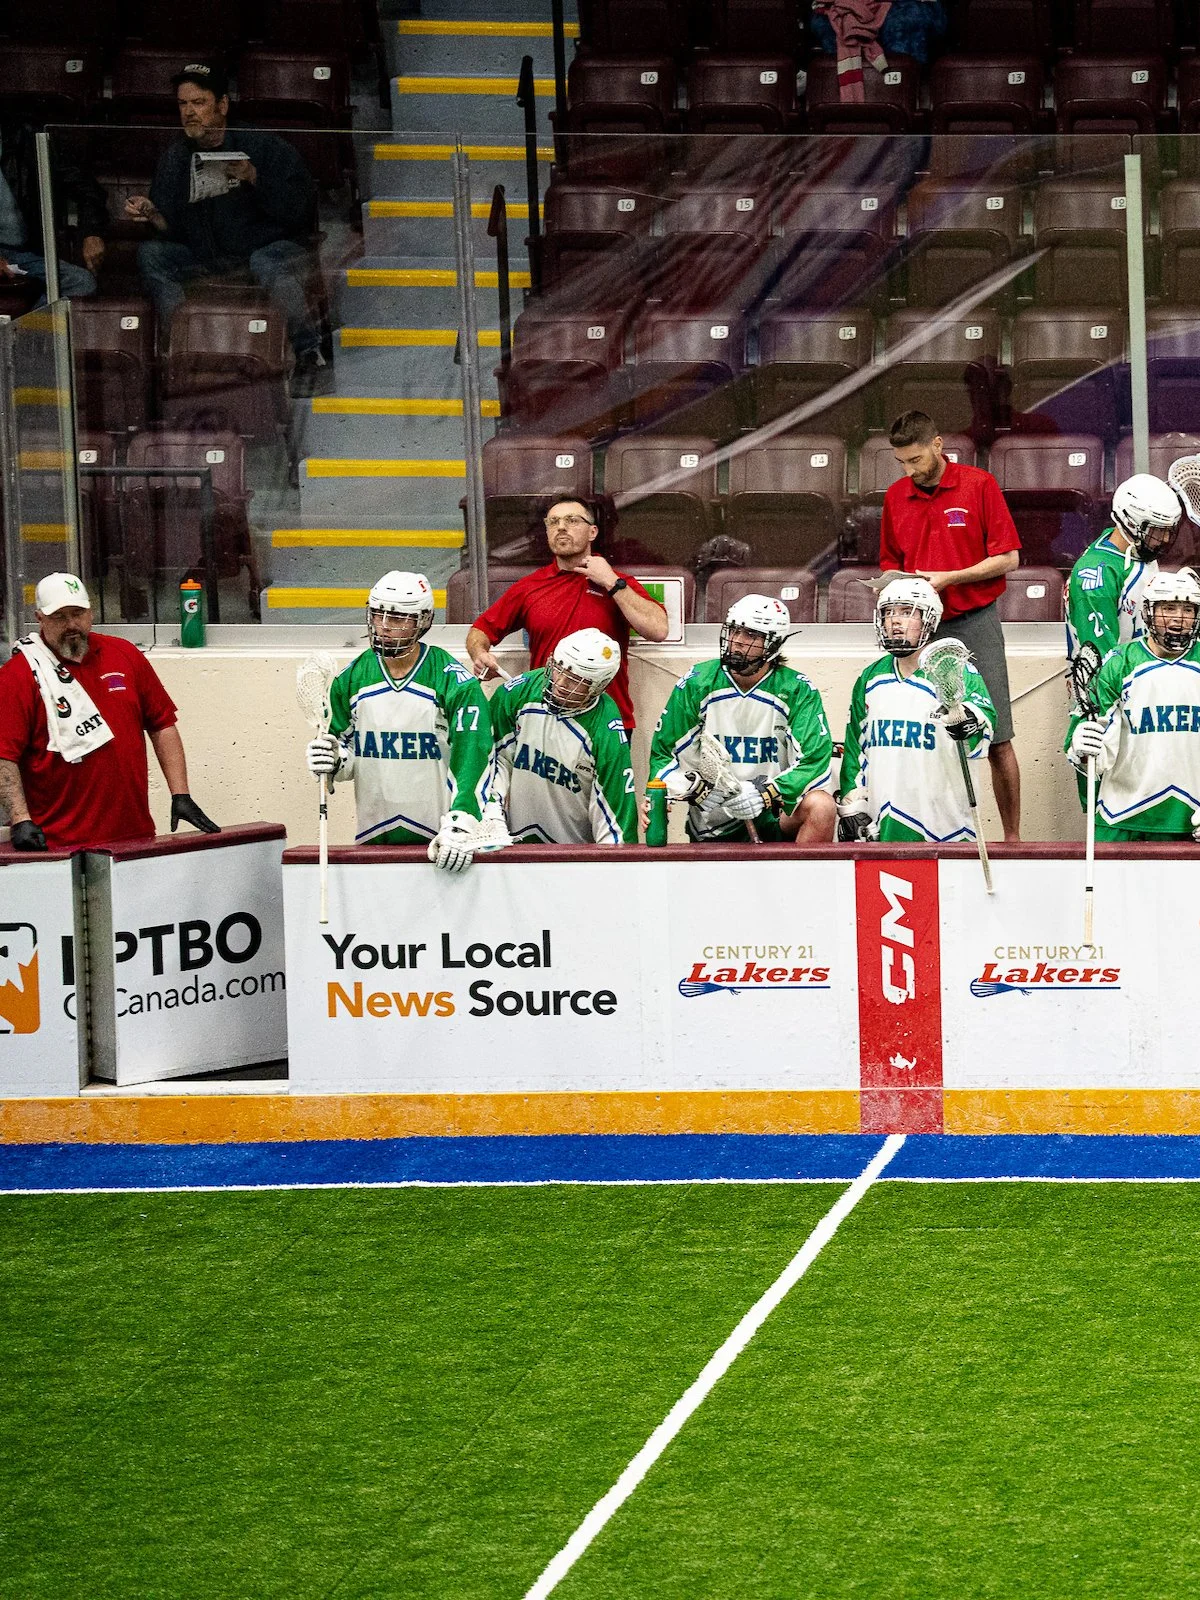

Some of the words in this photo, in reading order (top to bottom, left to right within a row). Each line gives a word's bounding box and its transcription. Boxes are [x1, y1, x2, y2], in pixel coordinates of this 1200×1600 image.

[455, 705, 481, 733] 17
[321, 932, 427, 970] Your
[441, 929, 552, 969] Local
[701, 945, 793, 960] CENTURY
[798, 945, 814, 960] 21
[993, 946, 1083, 960] CENTURY
[1089, 946, 1105, 960] 21
[687, 962, 831, 983] Lakers
[976, 963, 1121, 984] Lakers
[327, 981, 456, 1018] News
[468, 979, 618, 1018] Source
